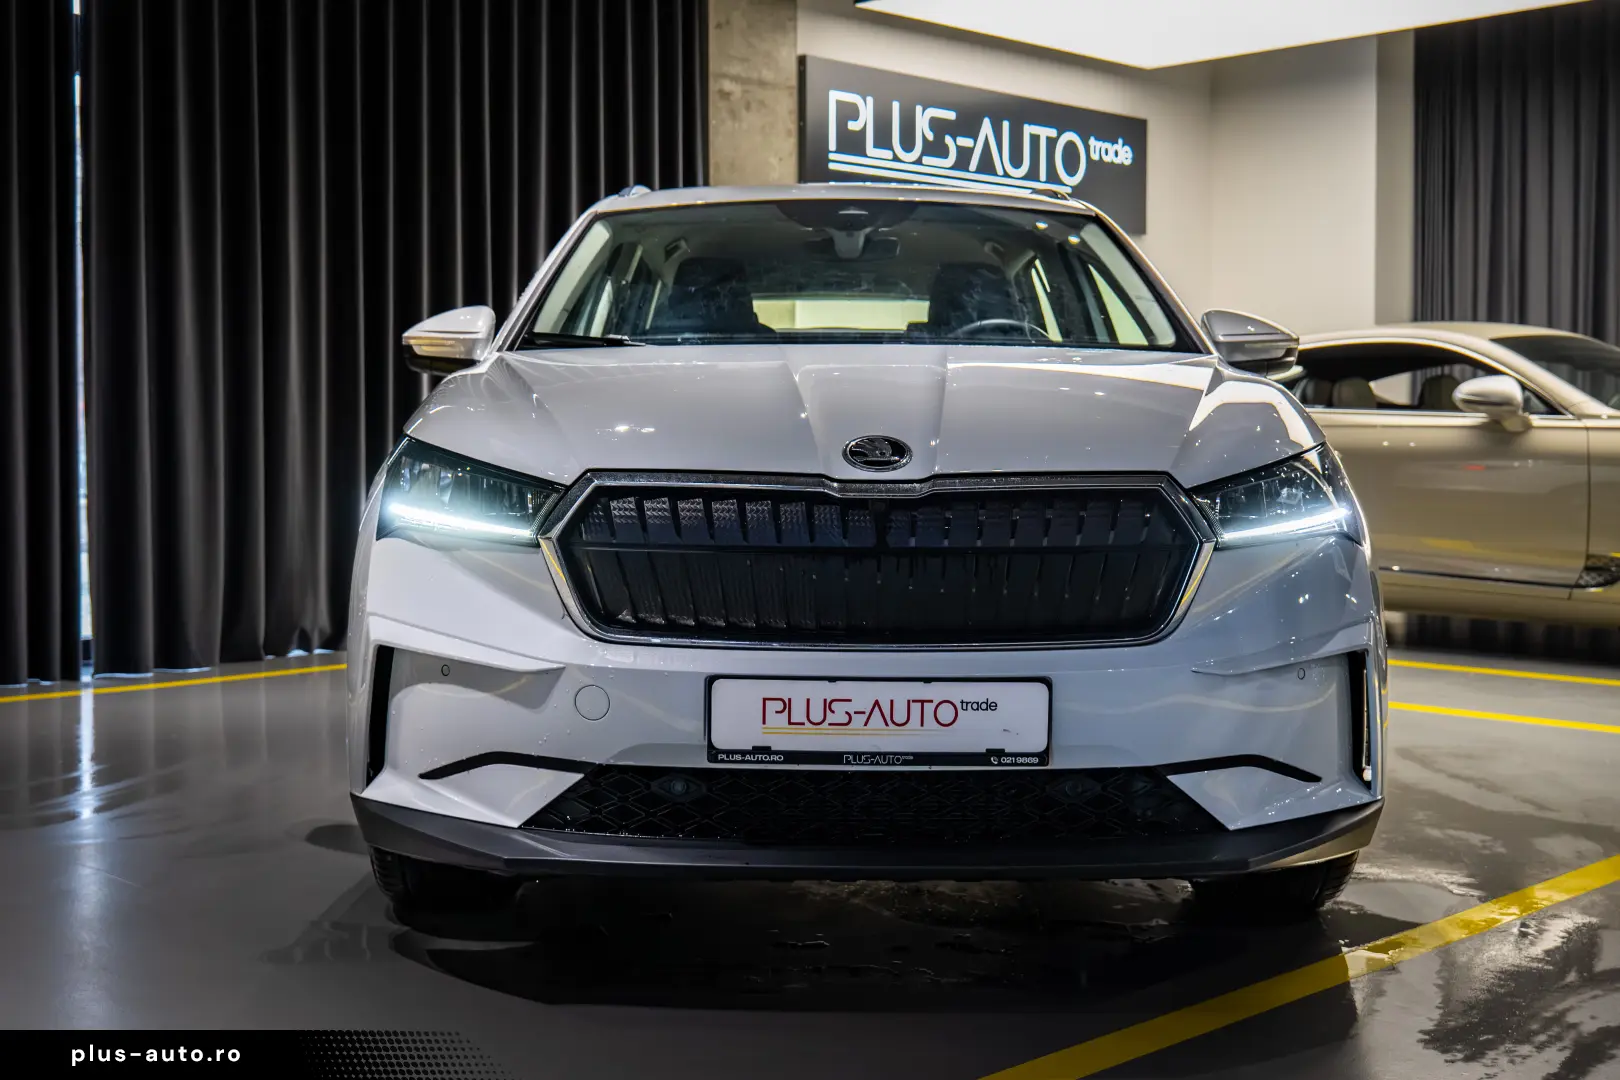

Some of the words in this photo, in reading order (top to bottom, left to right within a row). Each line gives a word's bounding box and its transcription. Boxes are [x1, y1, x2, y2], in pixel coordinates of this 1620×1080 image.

[828, 89, 1087, 187] PLUS-AUTO
[1088, 135, 1133, 166] trade
[762, 697, 959, 728] PLUS-AUTO
[959, 698, 998, 712] trade
[717, 753, 785, 762] PLUS-AUTO.RO
[843, 754, 903, 765] PLUS-AUTO
